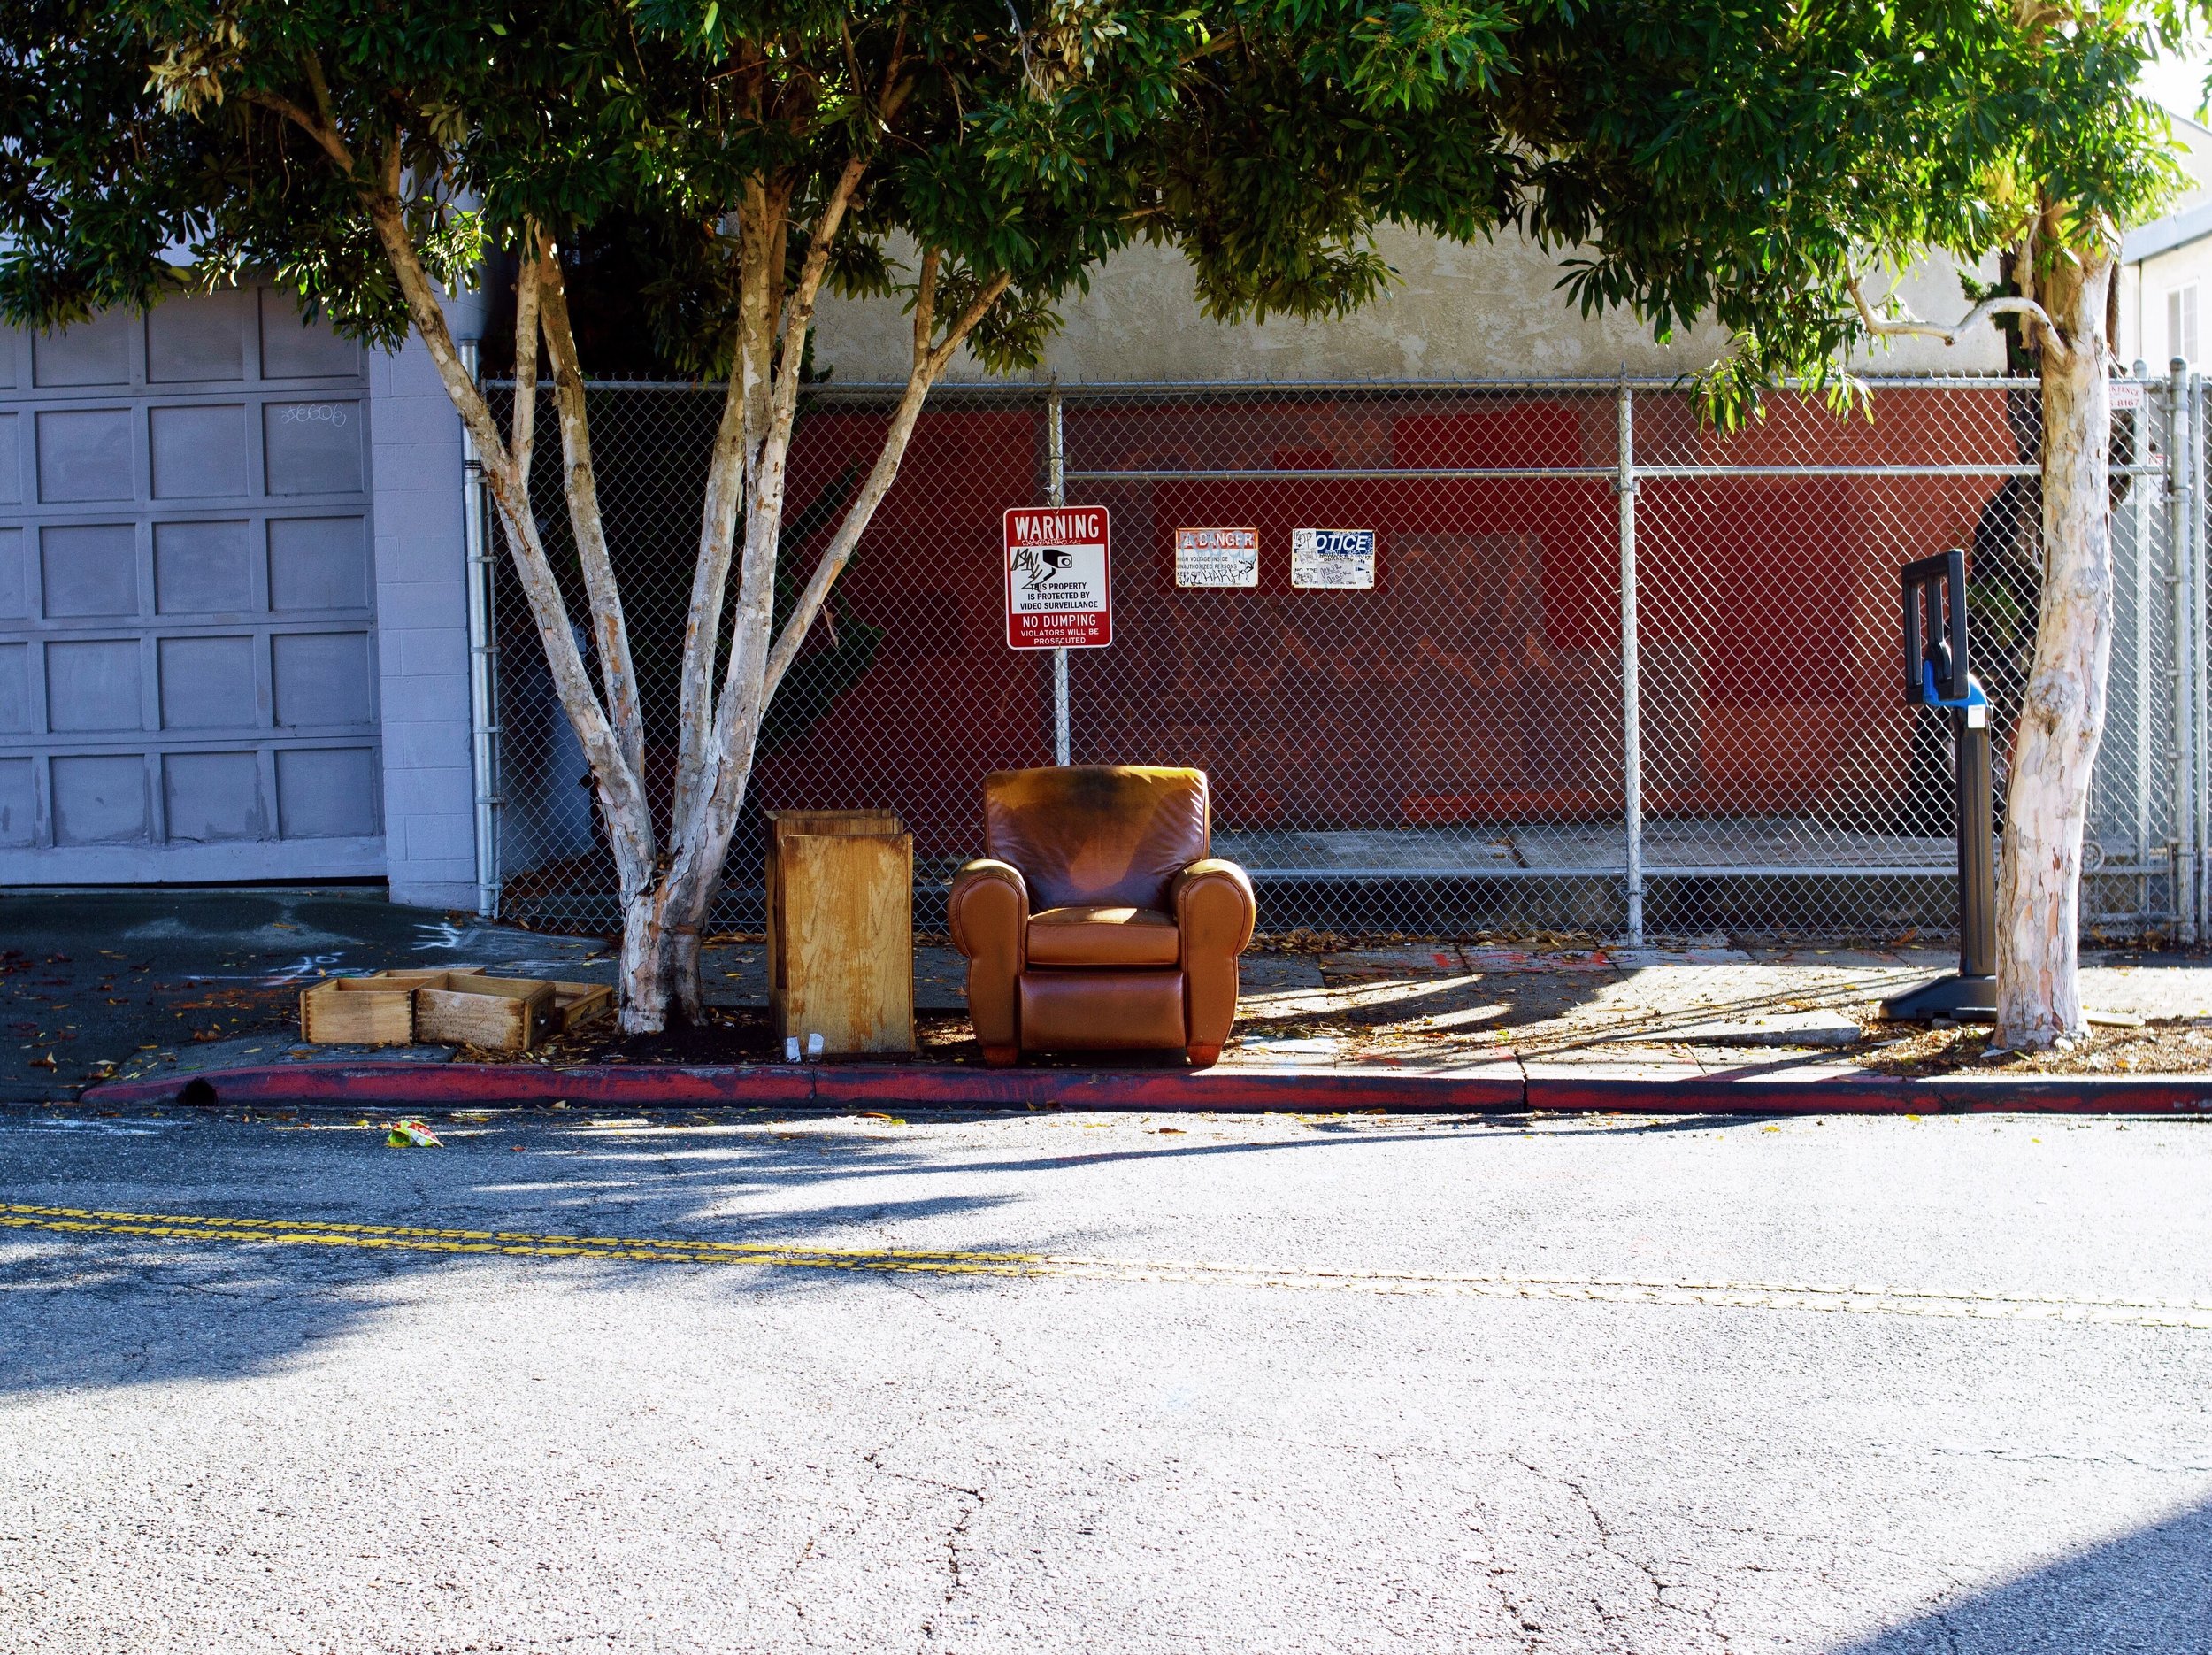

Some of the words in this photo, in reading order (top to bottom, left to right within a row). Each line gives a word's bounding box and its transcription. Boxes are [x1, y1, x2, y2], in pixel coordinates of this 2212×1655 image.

[1014, 514, 1099, 540] WARNING
[1315, 535, 1369, 551] OTICE
[1044, 601, 1098, 610] SURVEILLANCE
[1023, 616, 1038, 627] NO
[1043, 614, 1096, 627] DUMPING
